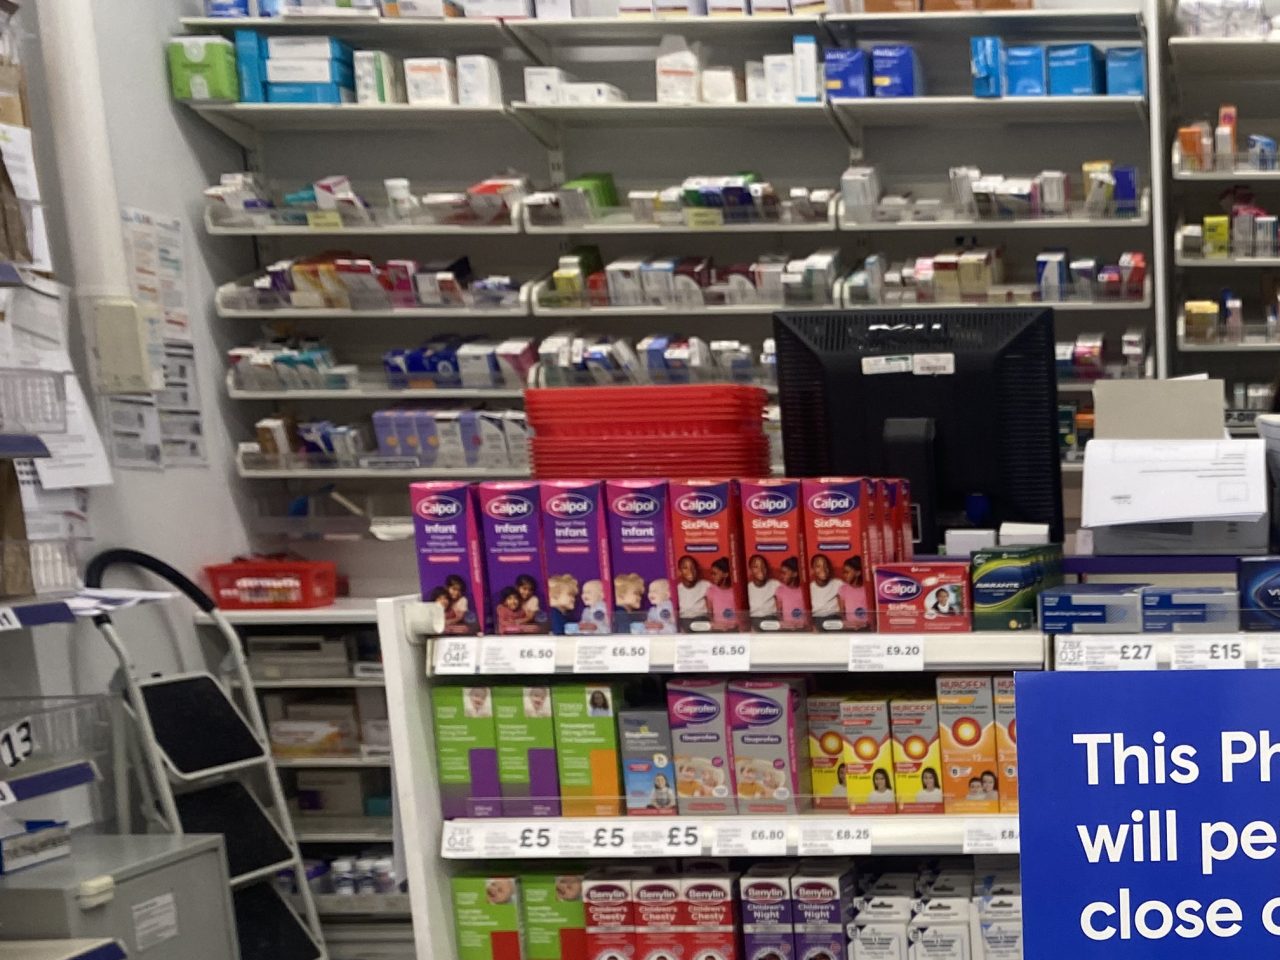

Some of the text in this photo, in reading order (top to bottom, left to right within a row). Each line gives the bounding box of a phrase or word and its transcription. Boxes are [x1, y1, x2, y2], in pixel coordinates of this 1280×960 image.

[813, 498, 850, 511] Calpol
[814, 518, 852, 529] SixPlus
[621, 527, 654, 536] Infant
[886, 646, 920, 656] £9.20
[1120, 644, 1152, 660] £27
[1209, 644, 1241, 660] £15
[738, 706, 779, 717] Calprofen
[2, 721, 34, 767] 13
[1072, 730, 1200, 786] This
[520, 829, 550, 847] £5
[594, 828, 624, 847] £5
[668, 827, 698, 846] £5
[751, 830, 784, 840] £6.80
[836, 830, 869, 840] £8.25
[1076, 809, 1178, 863] will
[689, 889, 724, 900] Benylin
[804, 911, 830, 921] Night
[1080, 887, 1243, 941] close
